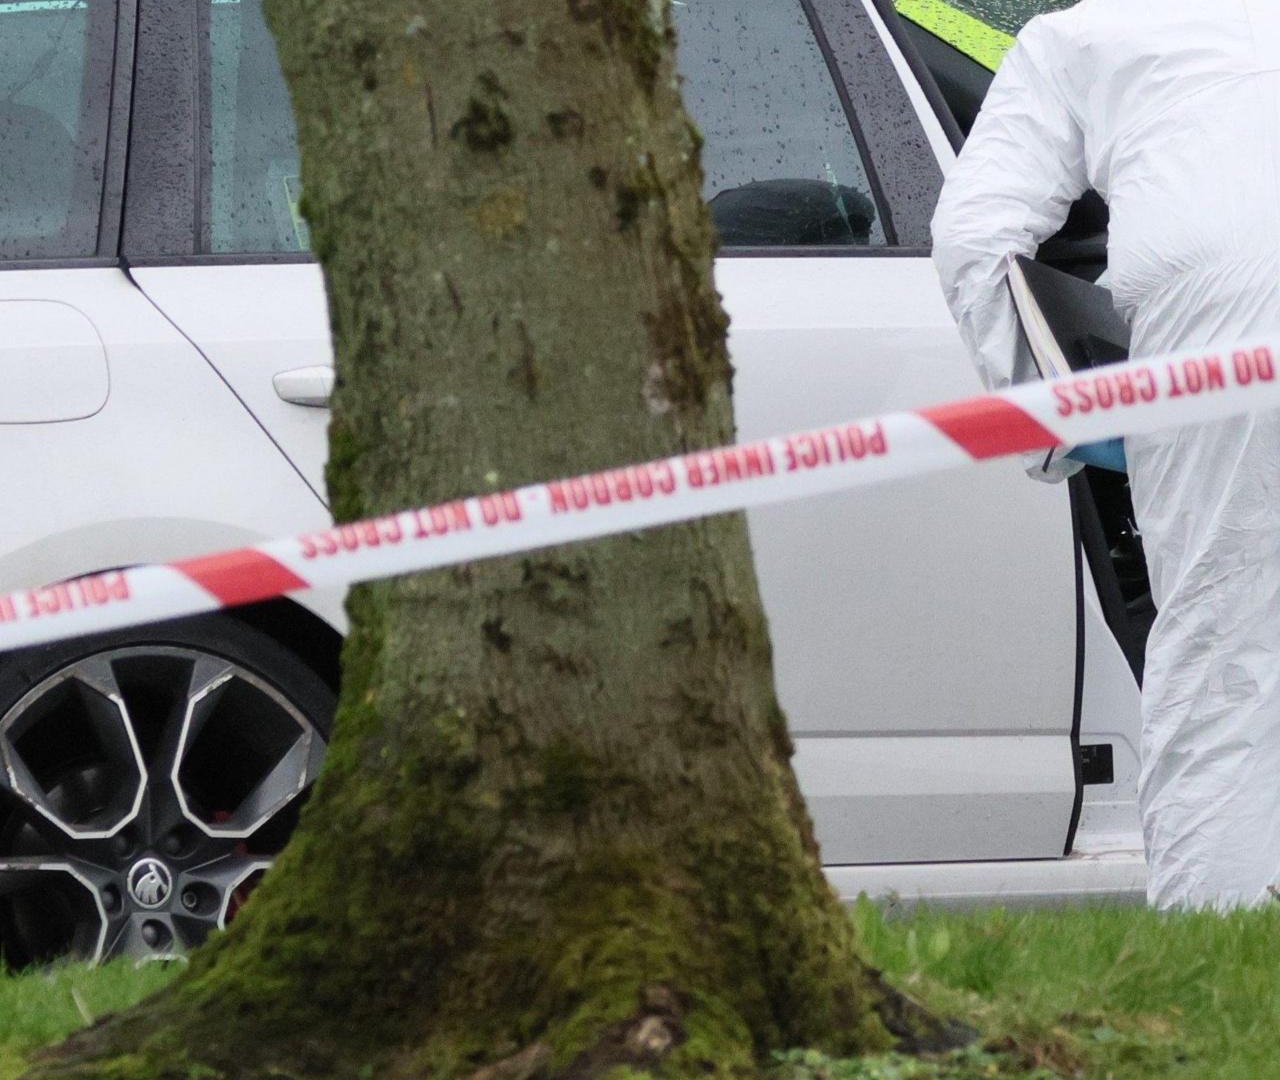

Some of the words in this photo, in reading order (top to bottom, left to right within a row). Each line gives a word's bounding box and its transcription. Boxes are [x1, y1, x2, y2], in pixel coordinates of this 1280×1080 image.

[1168, 358, 1227, 400] NOT
[1232, 348, 1277, 388] DO
[1053, 369, 1160, 419] CROSS
[684, 446, 777, 490] INNER
[785, 424, 891, 474] POLICE
[479, 489, 525, 529] DO
[547, 462, 679, 514] CORDON
[301, 513, 406, 562] CROSS
[414, 499, 474, 541] NOT
[26, 573, 134, 618] POLICE
